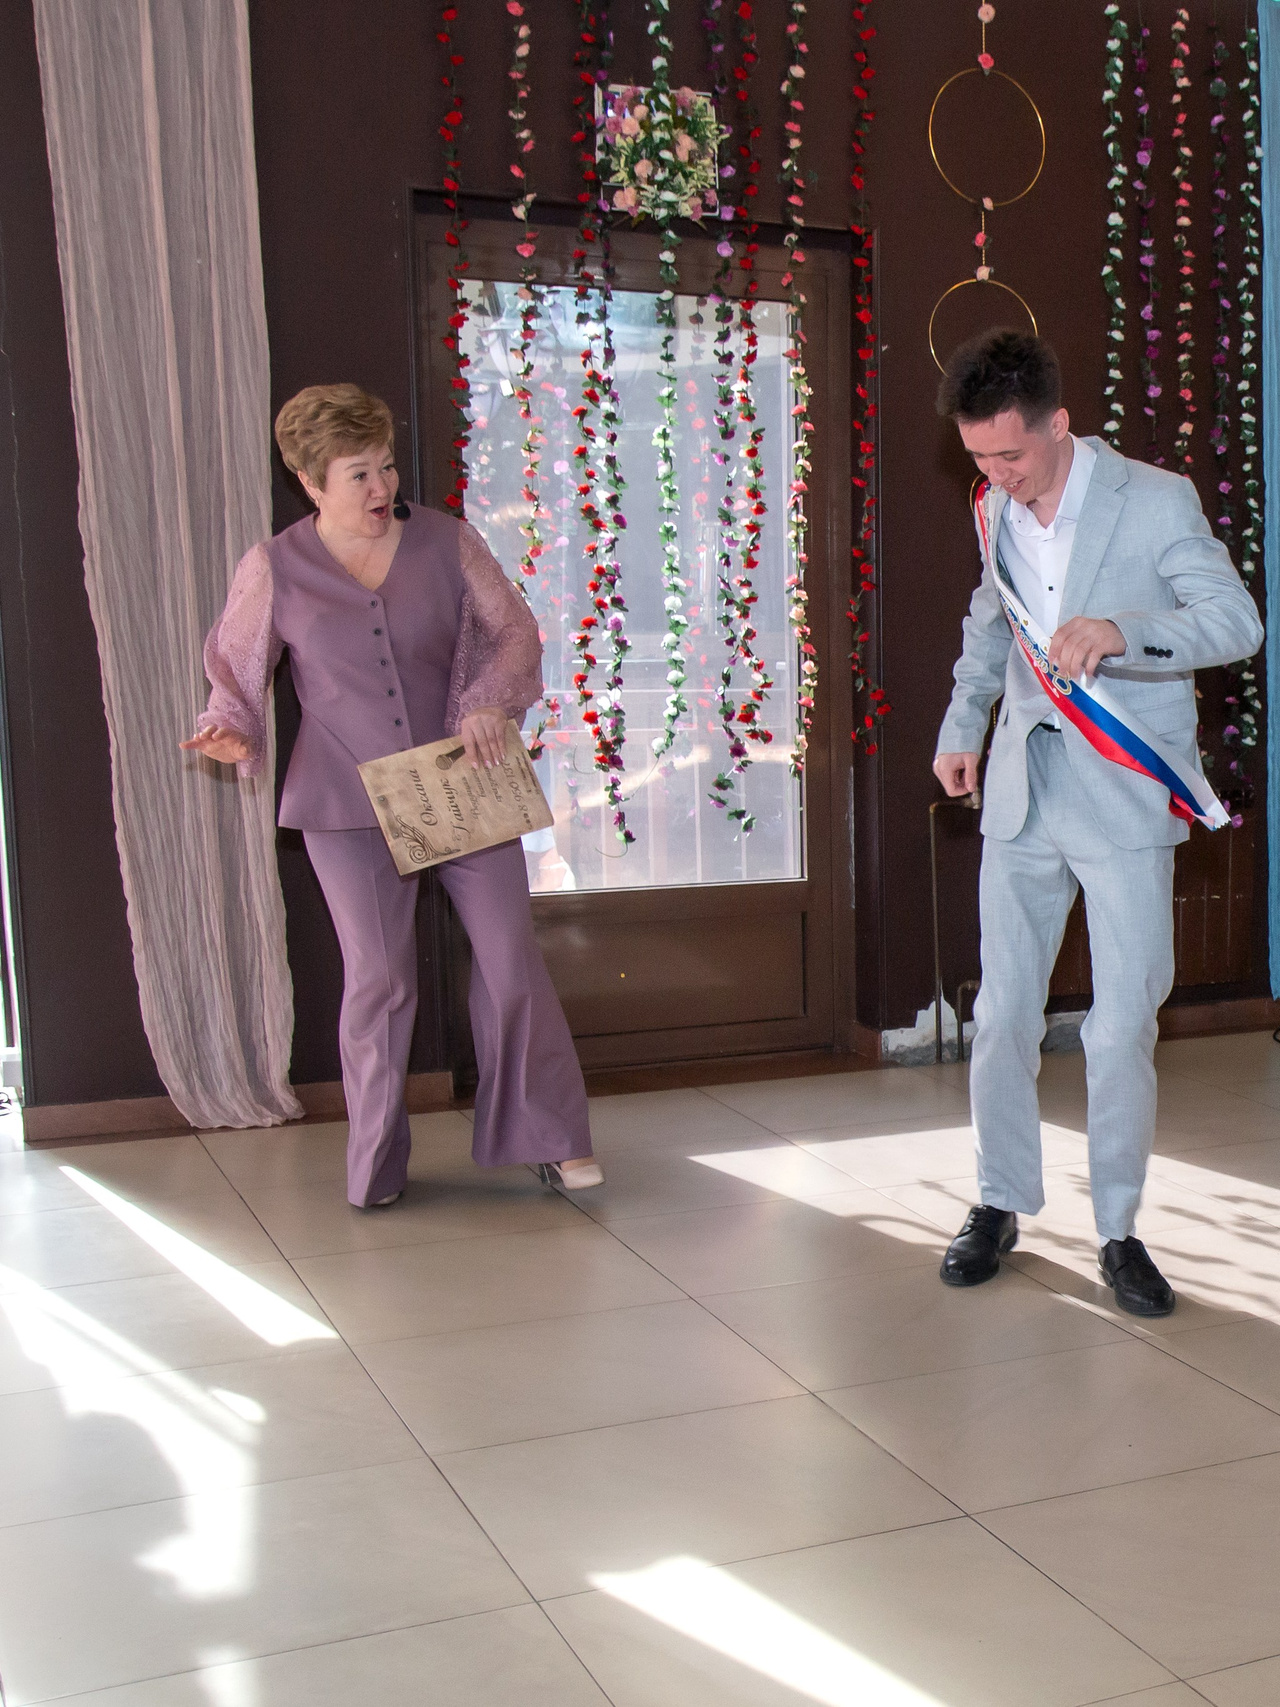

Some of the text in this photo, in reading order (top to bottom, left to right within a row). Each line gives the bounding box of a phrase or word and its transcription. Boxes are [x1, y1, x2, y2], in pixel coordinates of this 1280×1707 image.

[409, 768, 438, 826] Оксана
[439, 778, 472, 842] Гайчук
[509, 781, 522, 802] 950
